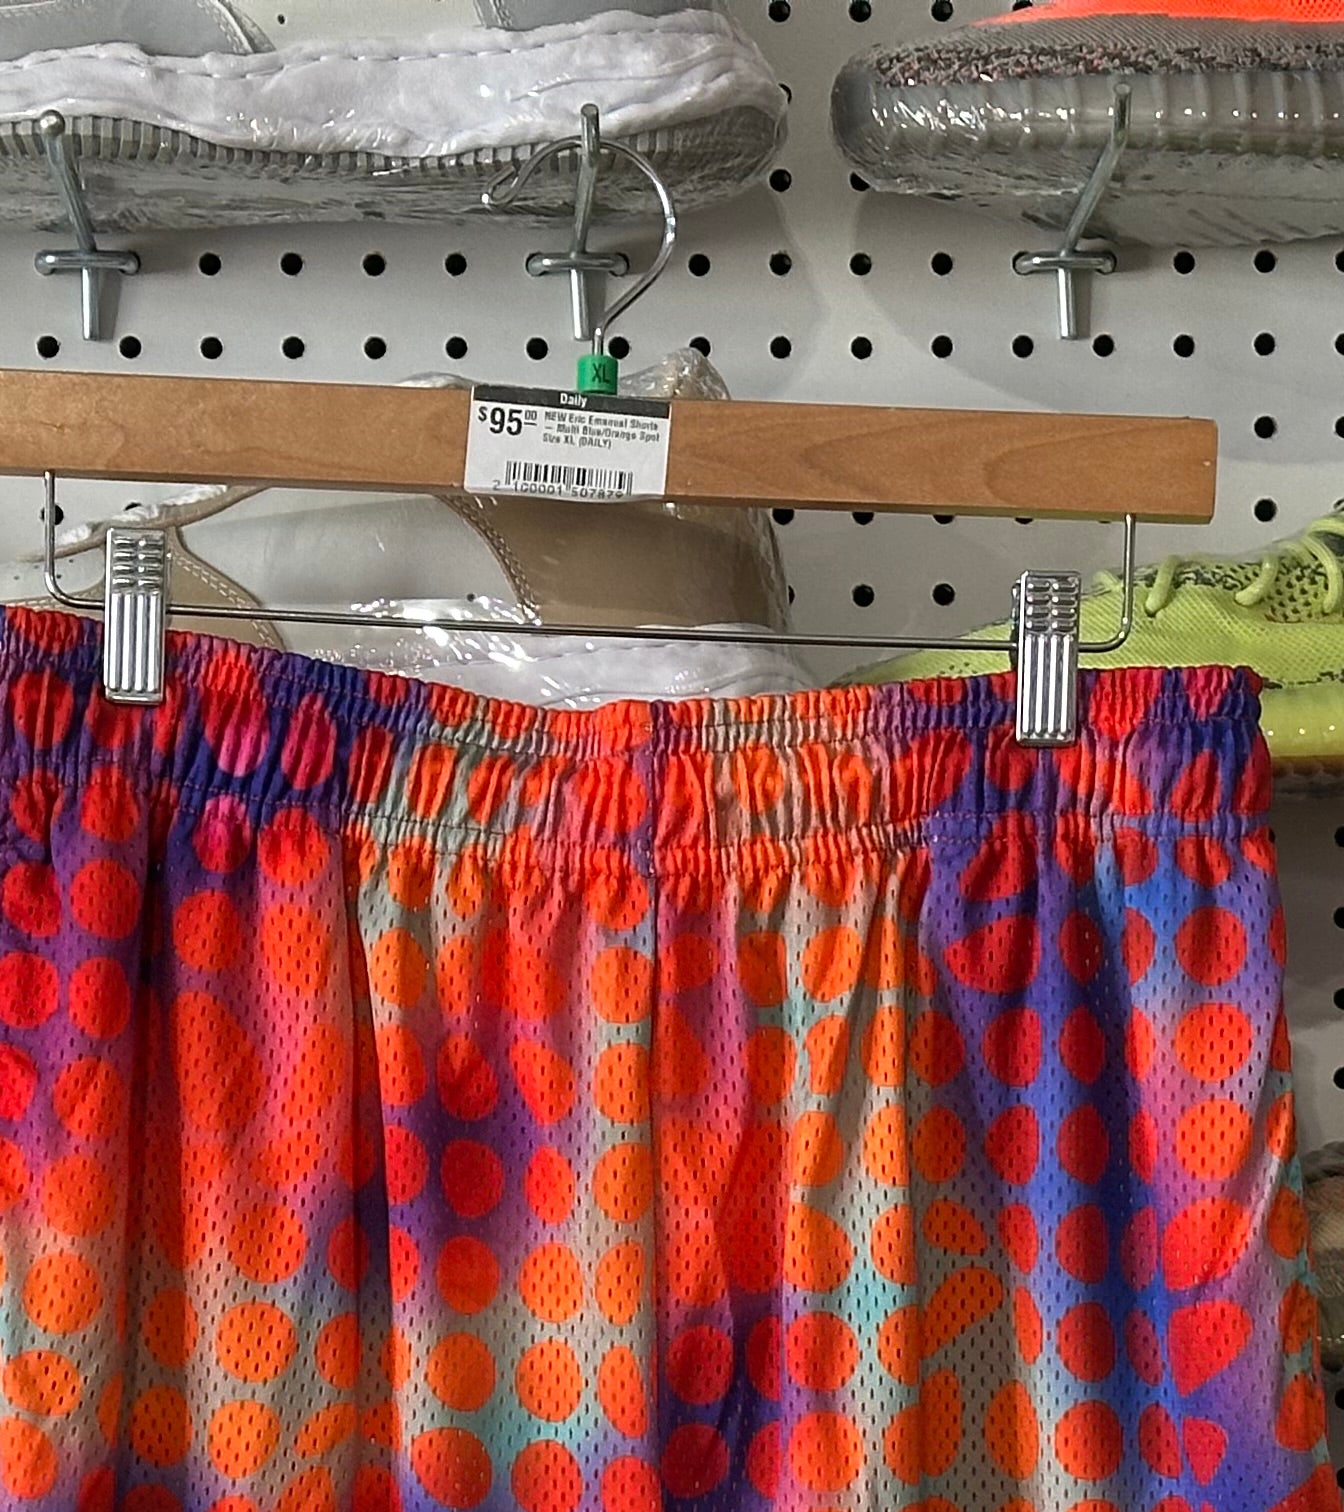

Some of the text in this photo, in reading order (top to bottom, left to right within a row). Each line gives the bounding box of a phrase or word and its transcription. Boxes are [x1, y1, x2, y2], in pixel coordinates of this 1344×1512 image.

[591, 362, 610, 383] XL
[560, 393, 588, 408] Daily
[544, 411, 567, 422] NEW
[542, 433, 561, 443] Size
[578, 437, 612, 450] (DAILY)
